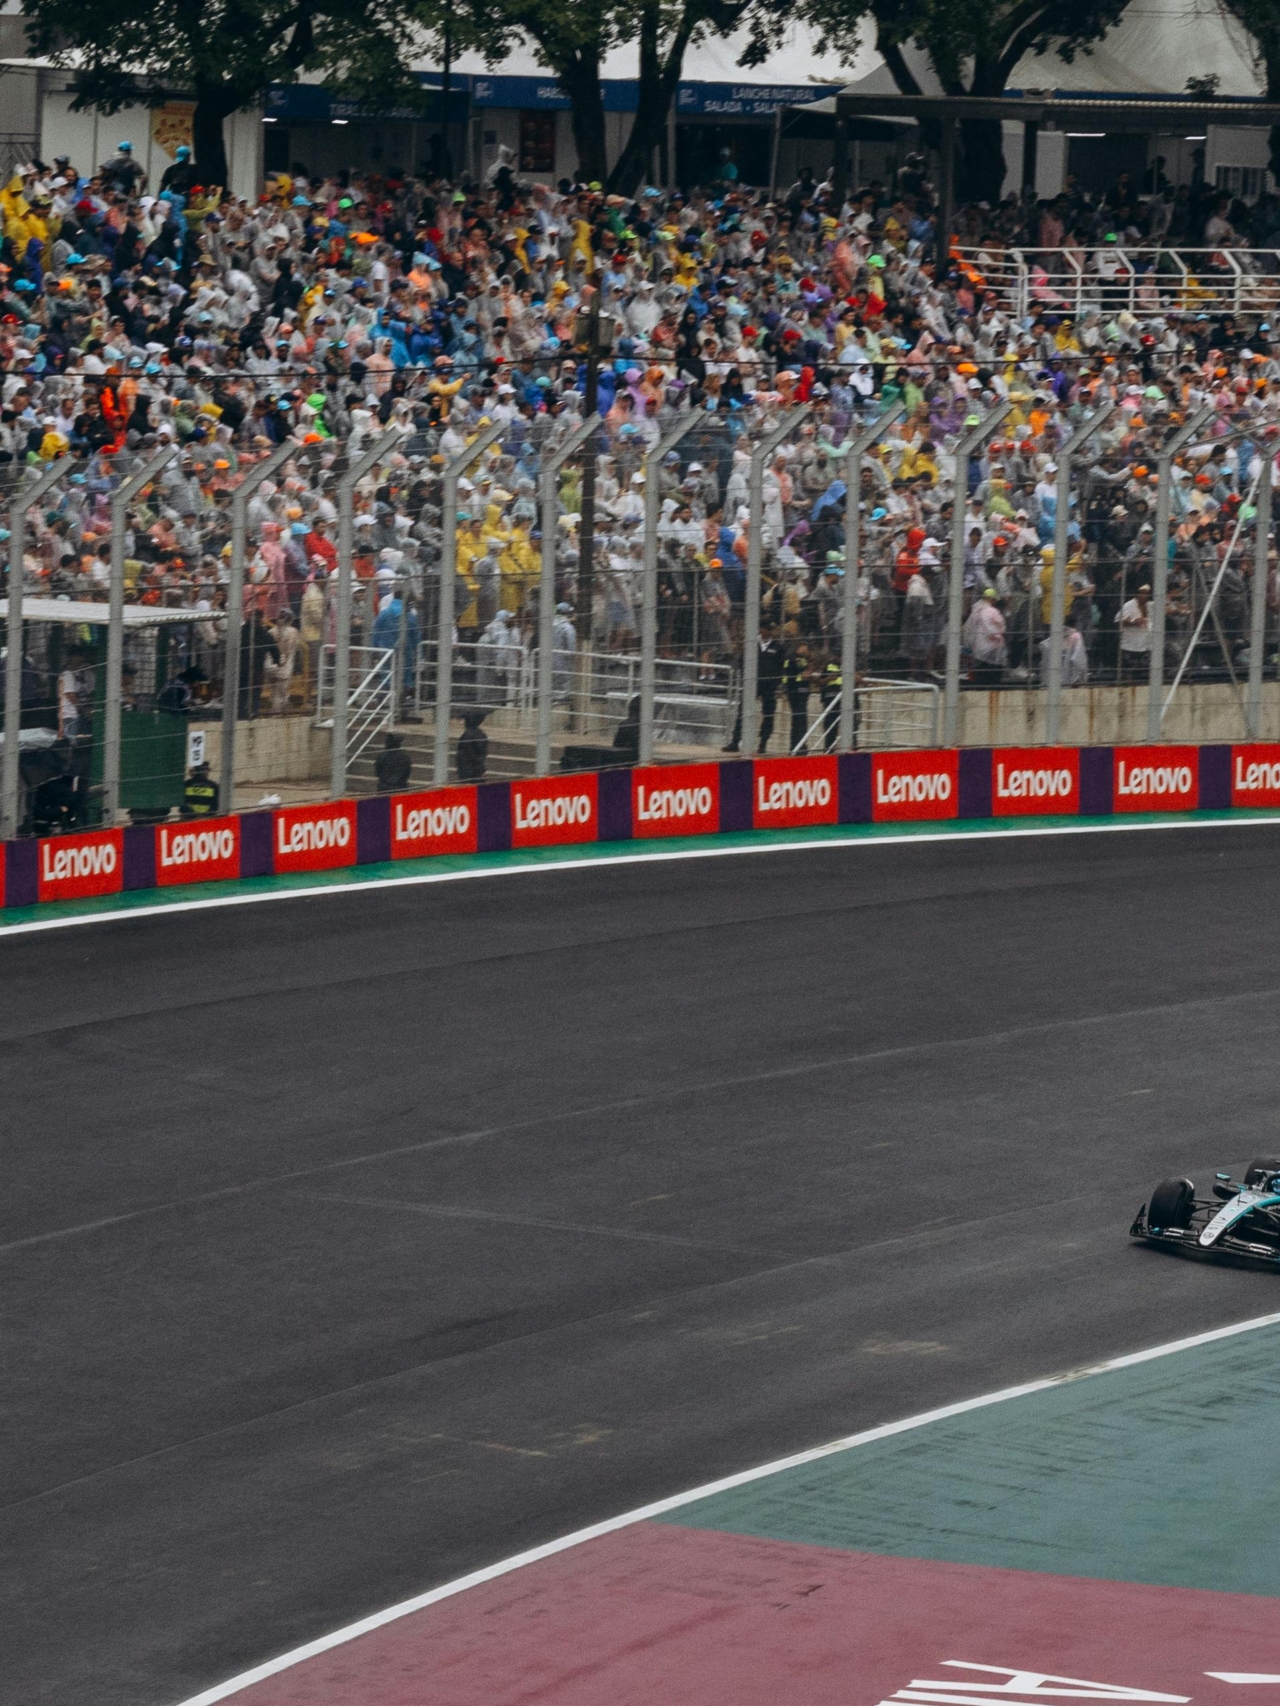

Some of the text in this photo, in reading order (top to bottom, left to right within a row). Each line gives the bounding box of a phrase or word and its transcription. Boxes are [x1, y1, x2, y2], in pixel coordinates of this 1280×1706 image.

[758, 776, 831, 811] Lenovo
[877, 769, 951, 804] Lenovo
[997, 763, 1072, 797] Lenovo
[1118, 760, 1192, 795] Lenovo
[515, 793, 591, 829] Lenovo
[637, 785, 712, 821] Lenovo
[278, 817, 351, 854] Lenovo
[395, 804, 470, 841] Lenovo
[43, 843, 117, 882] Lenovo
[161, 829, 234, 867] Lenovo
